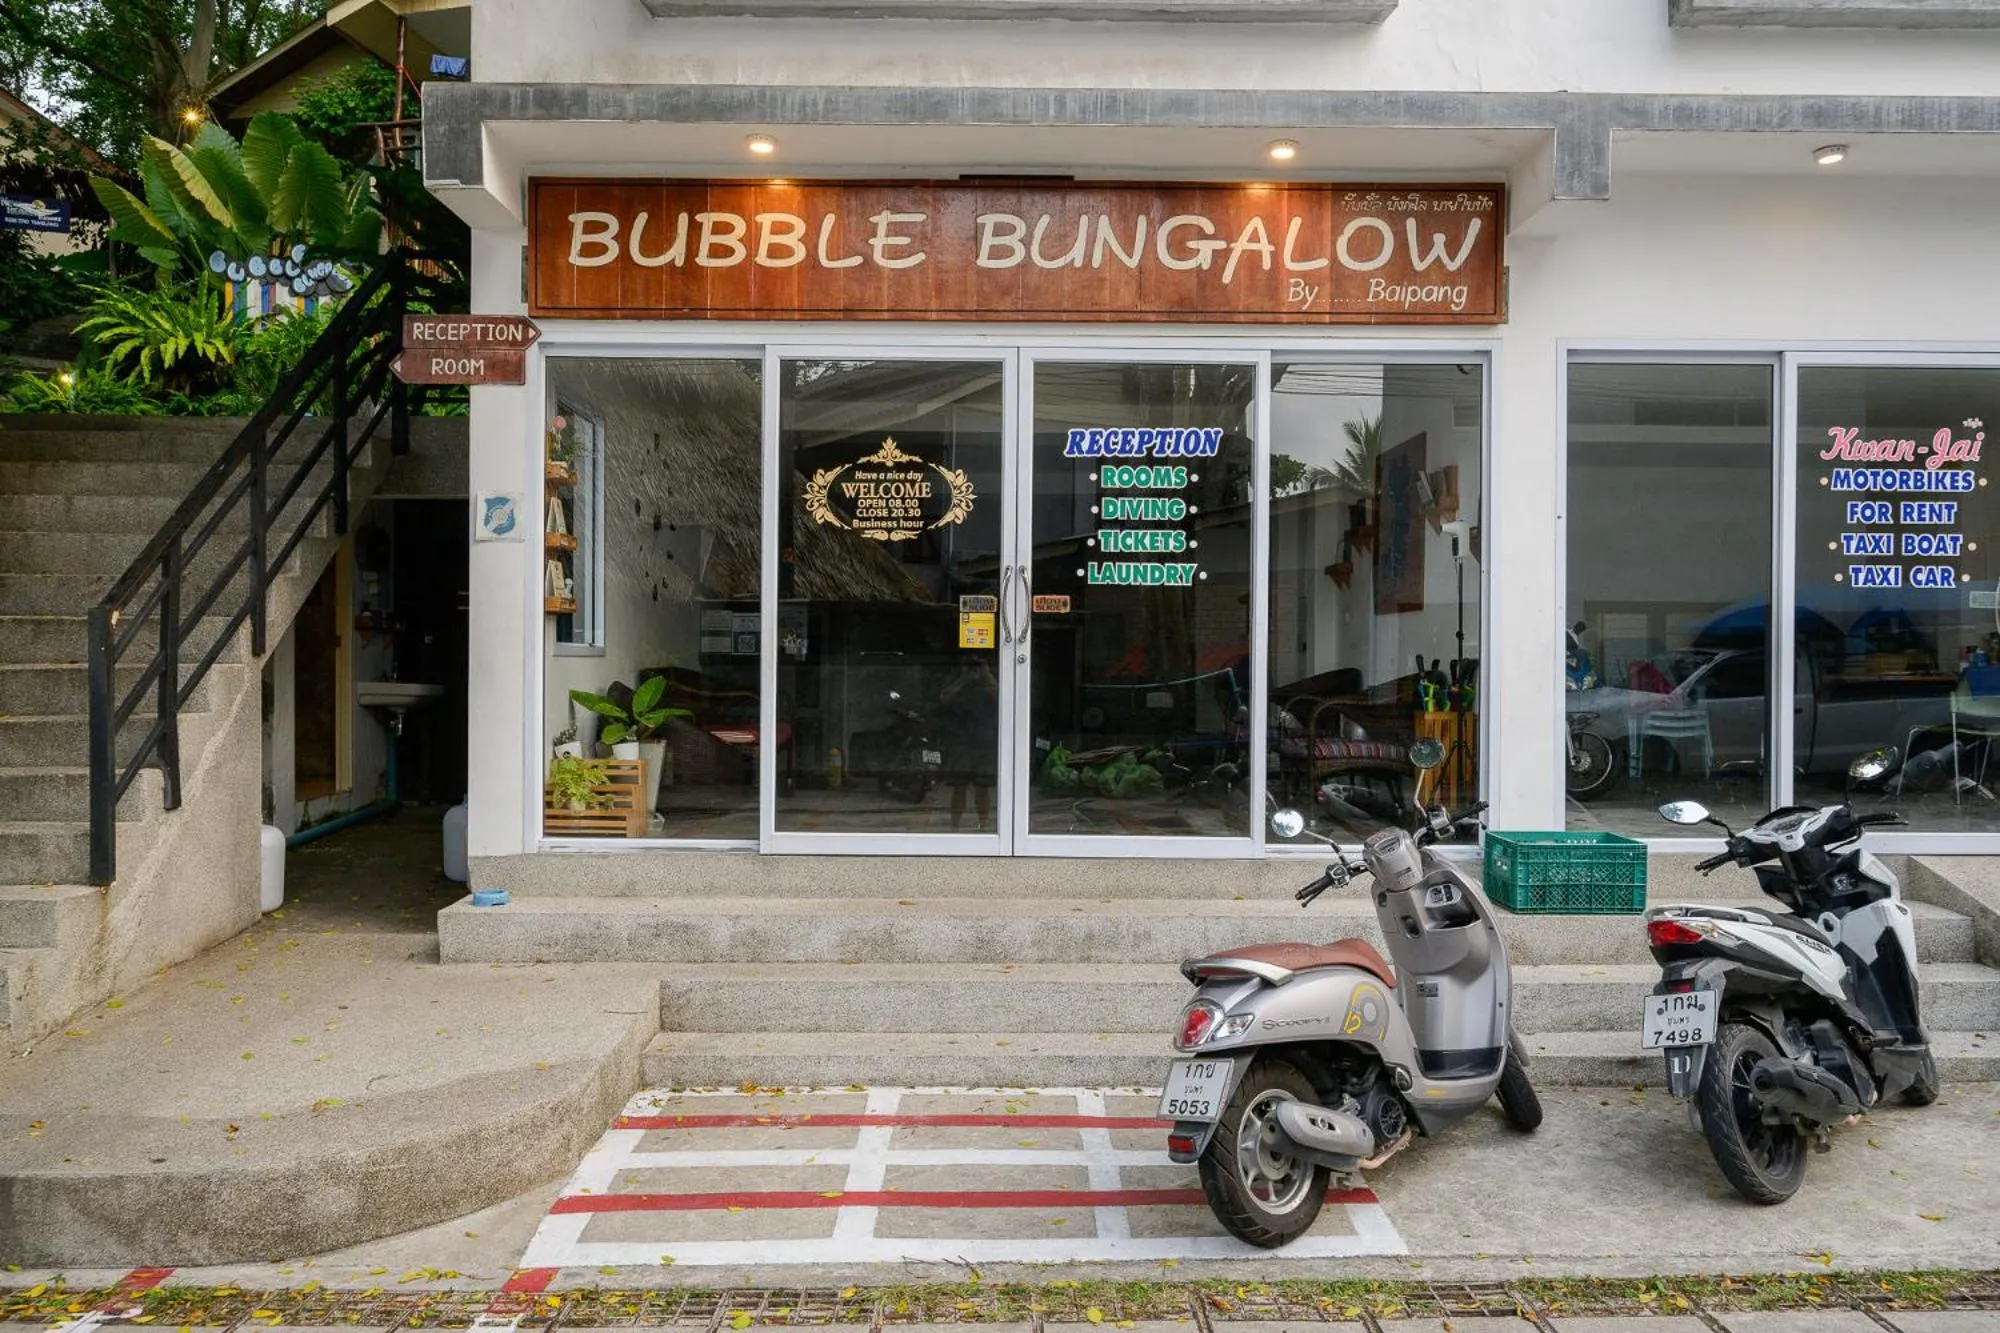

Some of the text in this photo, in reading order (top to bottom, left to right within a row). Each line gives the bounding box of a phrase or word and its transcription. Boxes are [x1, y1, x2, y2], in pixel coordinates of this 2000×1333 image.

[567, 209, 1482, 284] BUBBLE BUNGALOW
[1288, 277, 1468, 311] By Baipang
[412, 322, 523, 341] RECEPTION
[431, 358, 485, 376] ROOM
[1064, 427, 1223, 457] RECEPTION
[1820, 426, 1985, 470] Kwan-Jai
[855, 471, 878, 480] Have
[886, 470, 906, 480] nice
[907, 470, 924, 482] day
[1101, 465, 1188, 488] ROOMS
[1831, 468, 1975, 492] MOTORBIKES
[841, 481, 932, 498] WELCOME
[856, 508, 921, 518] CLOSE 20.30
[857, 498, 919, 508] OPEN 08.00
[1102, 497, 1187, 521] DIVING
[1847, 501, 1957, 524] FOR RENT
[852, 518, 925, 529] Business hour
[1098, 529, 1187, 552] TICKETS
[1841, 532, 1963, 557] TAXI BOAT
[1087, 561, 1198, 586] LAUNDRY
[1849, 565, 1957, 589] TAXI CAR
[1654, 1027, 1702, 1045] 7498
[1168, 1099, 1211, 1115] 5053
